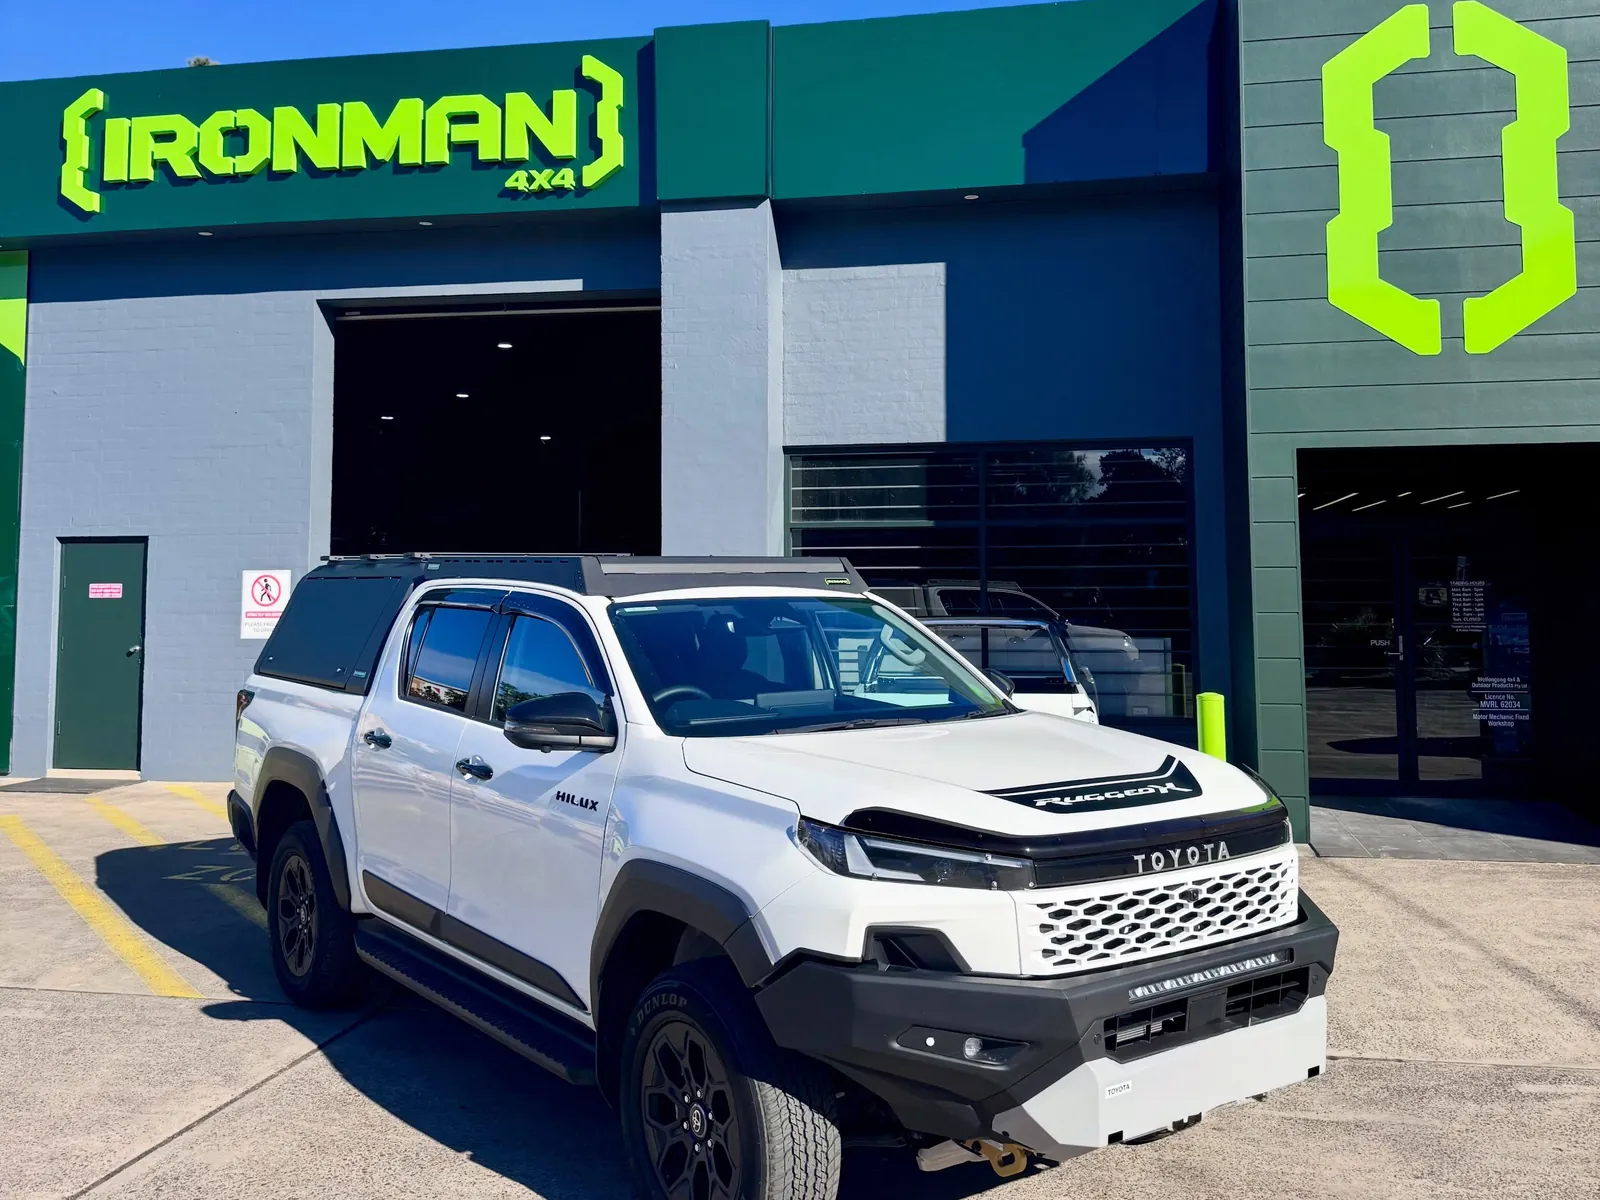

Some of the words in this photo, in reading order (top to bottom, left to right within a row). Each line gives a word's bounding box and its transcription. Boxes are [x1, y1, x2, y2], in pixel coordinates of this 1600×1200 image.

[103, 88, 577, 184] IRONMAN
[556, 790, 599, 811] HILUX
[1133, 840, 1231, 874] TOYOTA
[636, 992, 688, 1027] DUNLOP
[1107, 1083, 1130, 1096] TOYOTA
